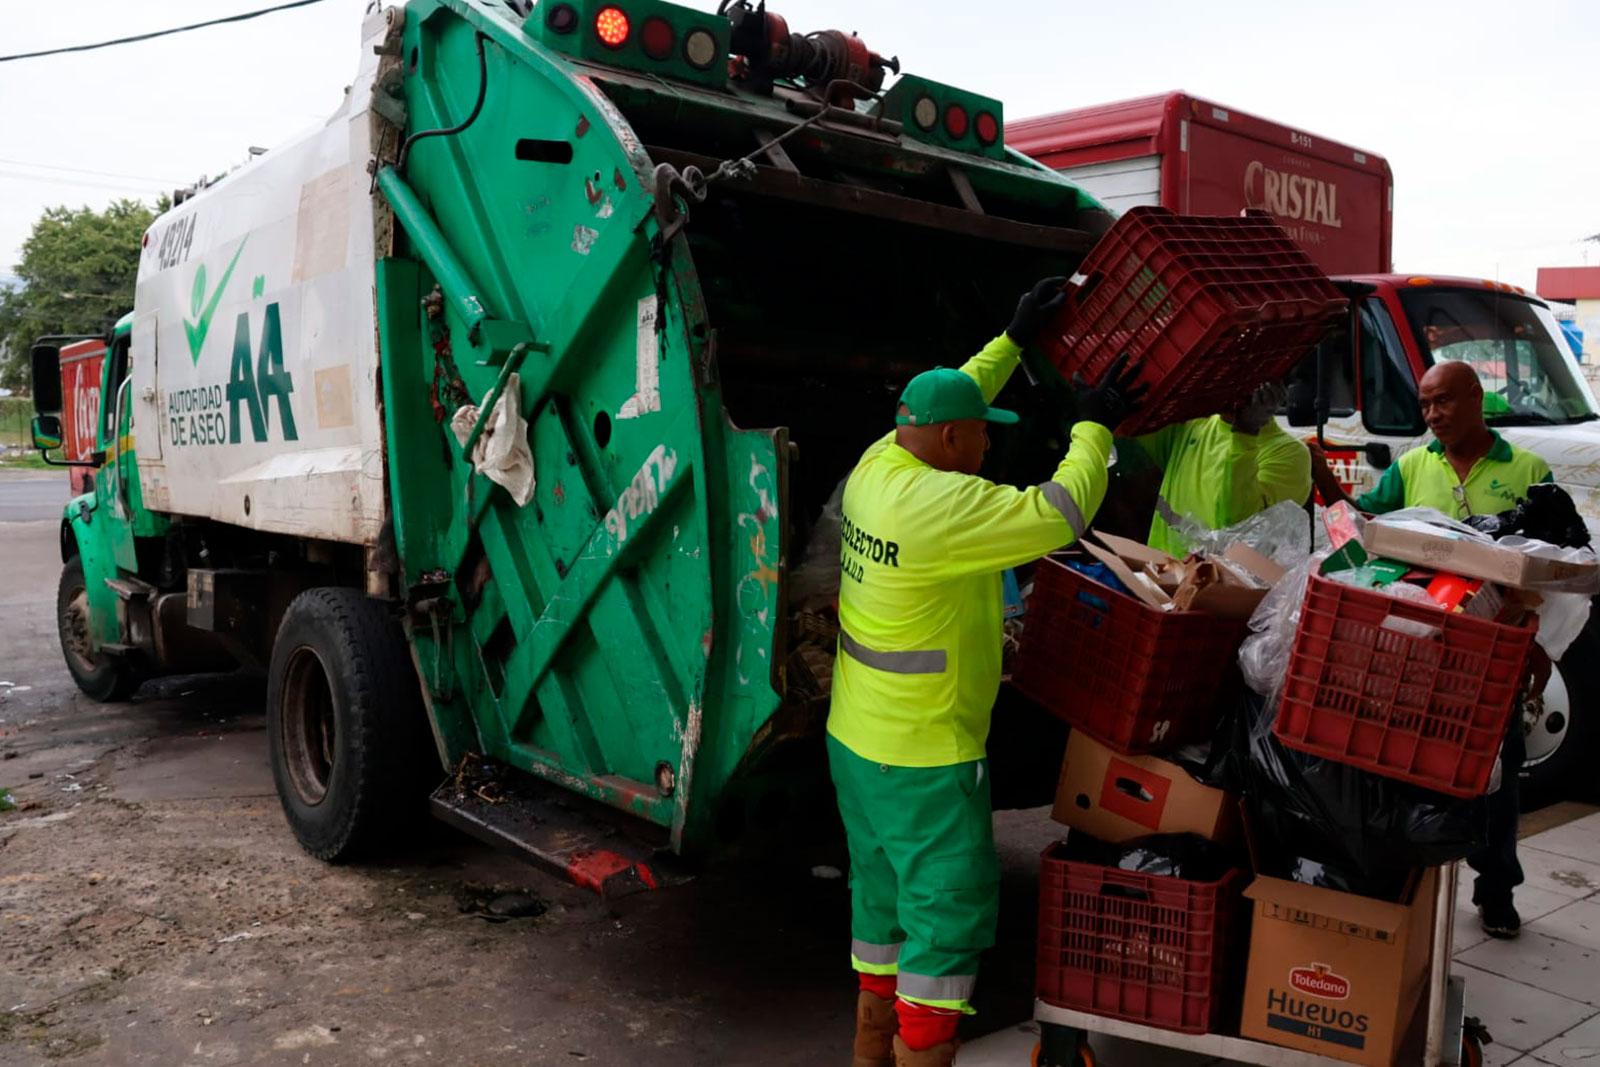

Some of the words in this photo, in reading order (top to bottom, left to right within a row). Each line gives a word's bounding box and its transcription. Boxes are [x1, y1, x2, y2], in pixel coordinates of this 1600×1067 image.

[1244, 161, 1341, 227] CRISTAL
[169, 385, 222, 413] AUTORIDAD
[170, 417, 187, 446] DE
[190, 412, 226, 446] ASEO
[840, 512, 899, 568] COLECTOR
[1294, 972, 1346, 994] Toledano
[1267, 988, 1369, 1033] Huevos
